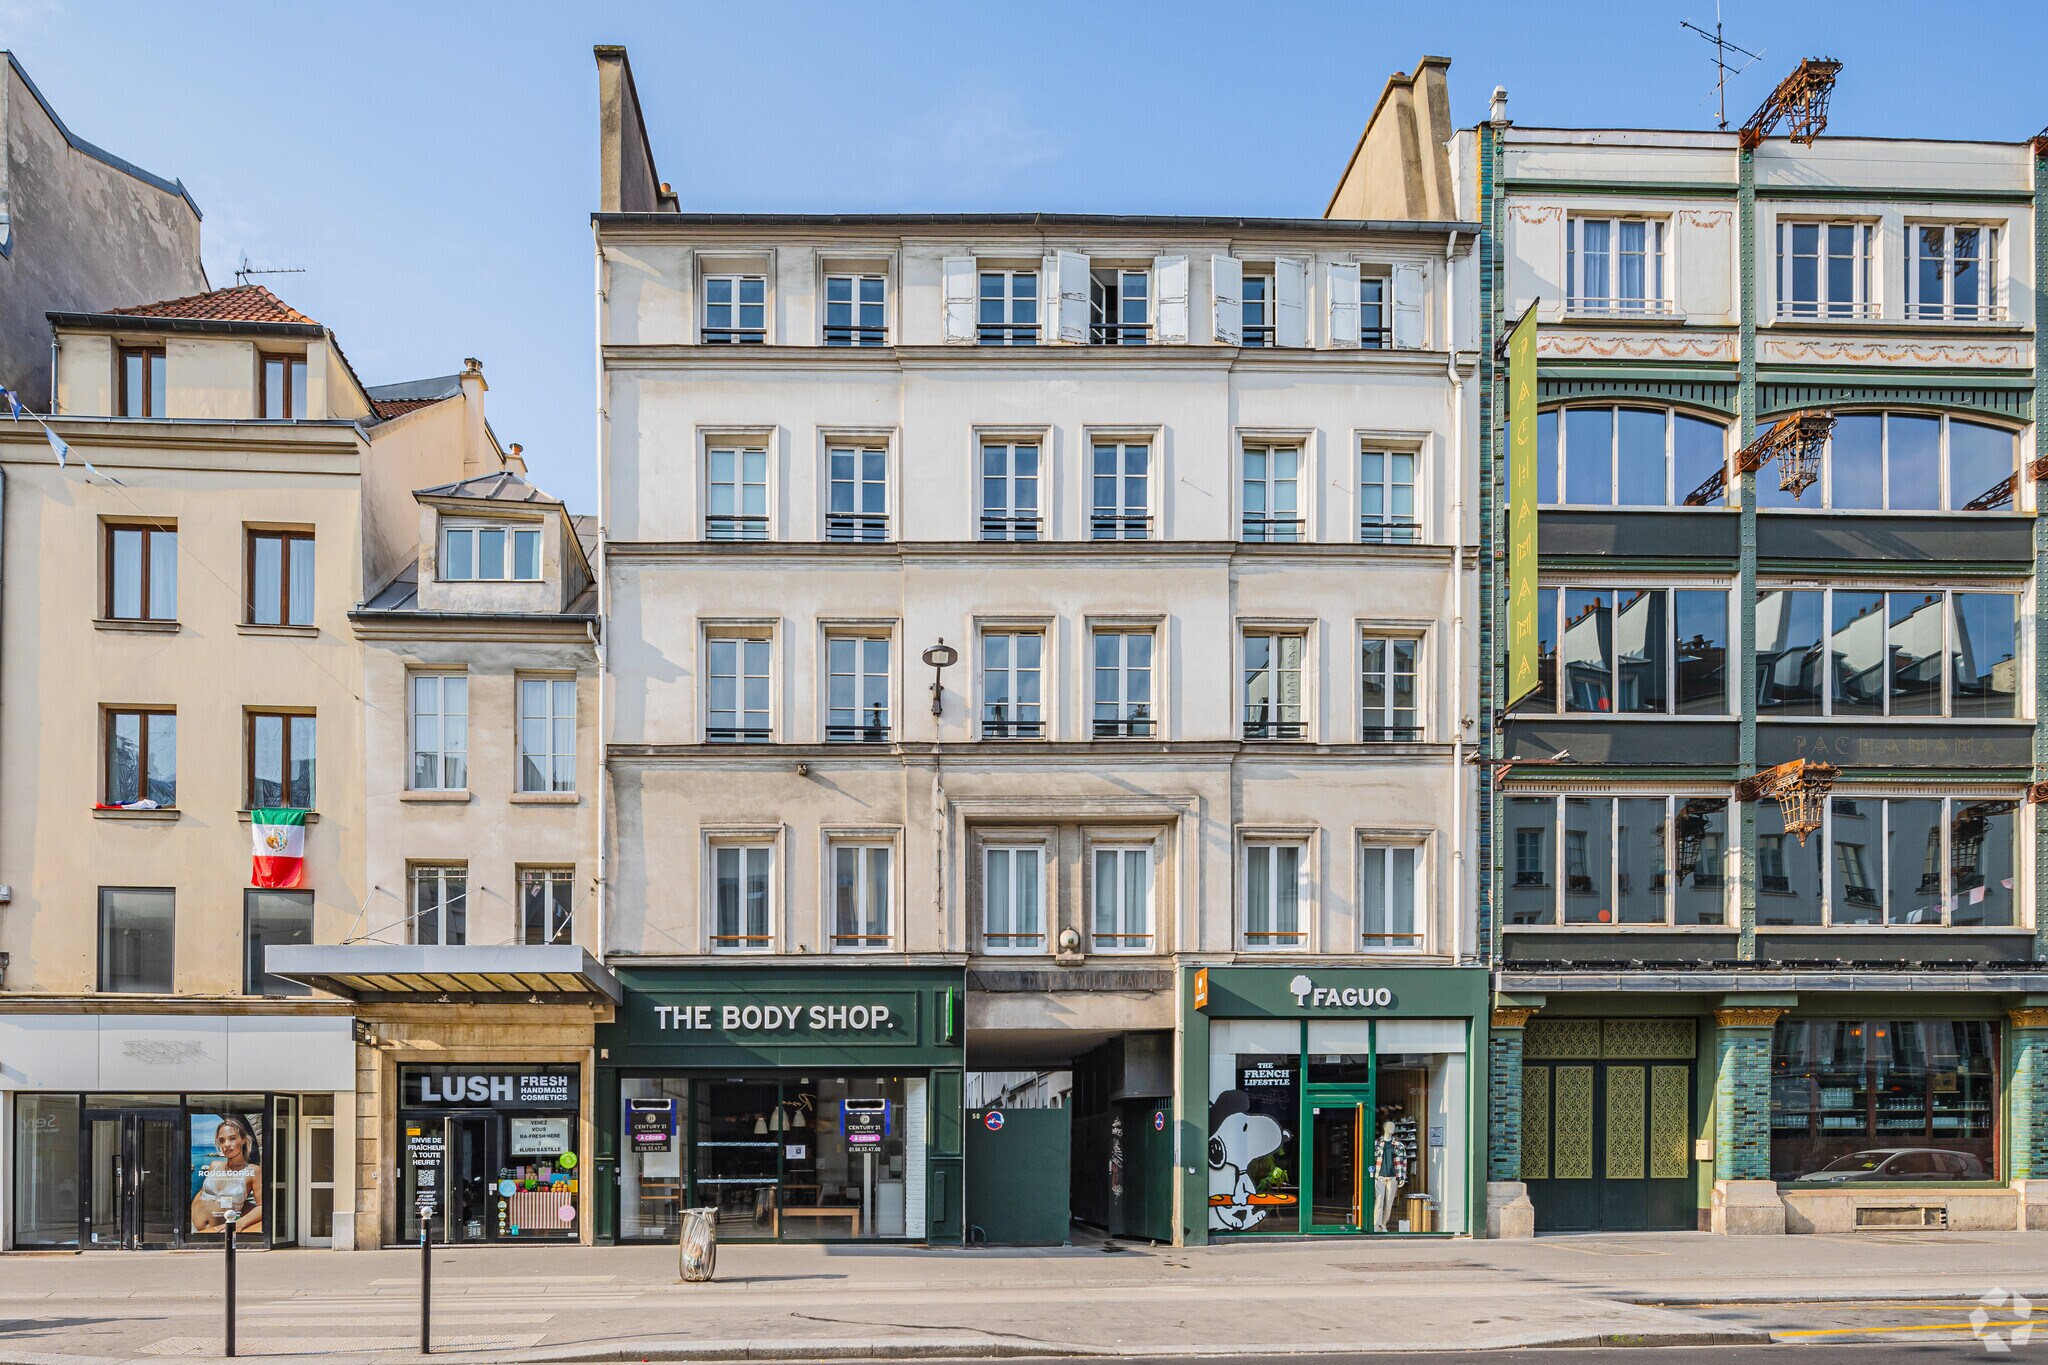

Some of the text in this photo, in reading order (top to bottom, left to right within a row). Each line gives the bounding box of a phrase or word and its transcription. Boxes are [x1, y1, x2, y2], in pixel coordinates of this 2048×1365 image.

[1516, 336, 1532, 684] PACHAMAMA
[1793, 736, 1997, 755] PACHAMAMA
[1313, 988, 1392, 1007] FAGUO
[654, 1006, 712, 1030] THE
[722, 1005, 803, 1030] BODY
[520, 1076, 568, 1087] FRESH
[1244, 1069, 1290, 1078] FRENCH
[1244, 1078, 1291, 1086] LIFESTYLE
[421, 1076, 514, 1102] LUSH
[407, 1143, 446, 1151] FRAÎCHEUR
